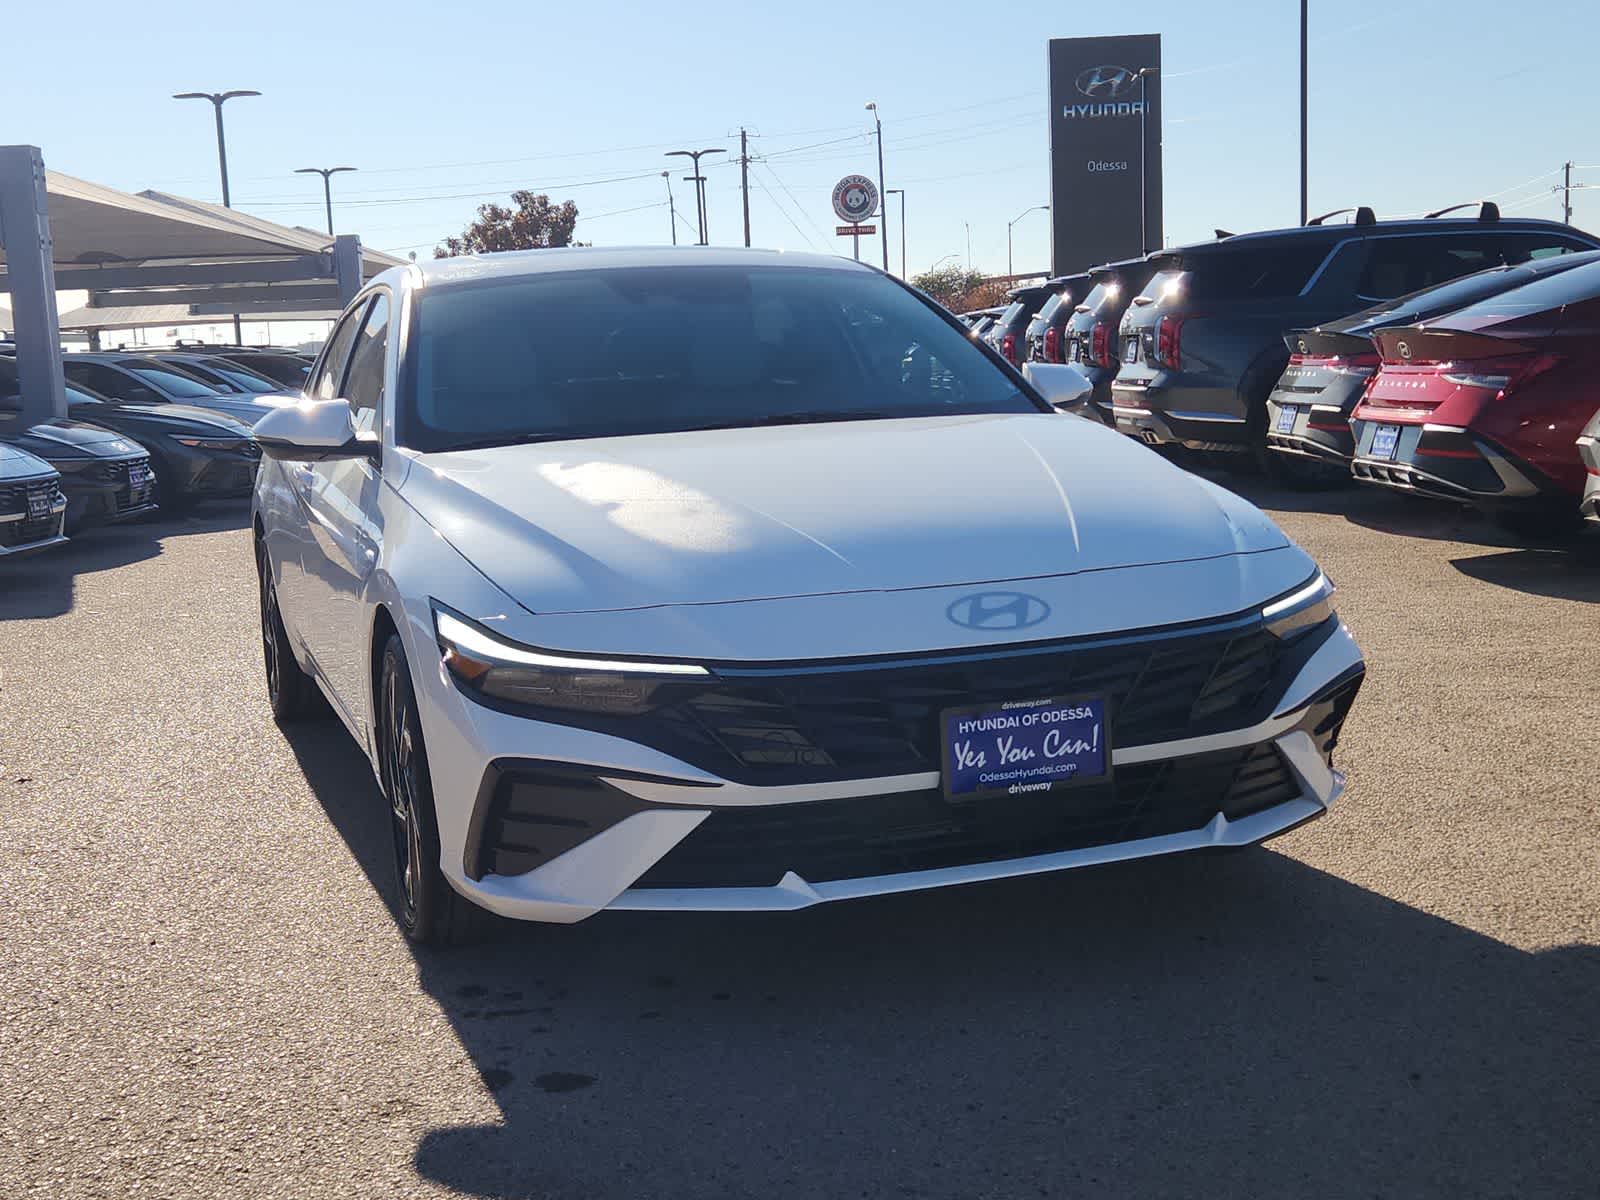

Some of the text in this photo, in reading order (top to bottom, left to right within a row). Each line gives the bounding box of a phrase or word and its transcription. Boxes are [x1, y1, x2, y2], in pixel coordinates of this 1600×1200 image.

[1063, 102, 1150, 118] HYUNDAI
[1087, 160, 1127, 172] Odessa
[1001, 698, 1052, 710] driveway.com
[959, 707, 1093, 734] HYUNDAI OF ODESSA
[954, 723, 1099, 770] Yes You Can!
[979, 762, 1077, 783] OdessaHyundai.com
[1008, 781, 1052, 794] driveway
